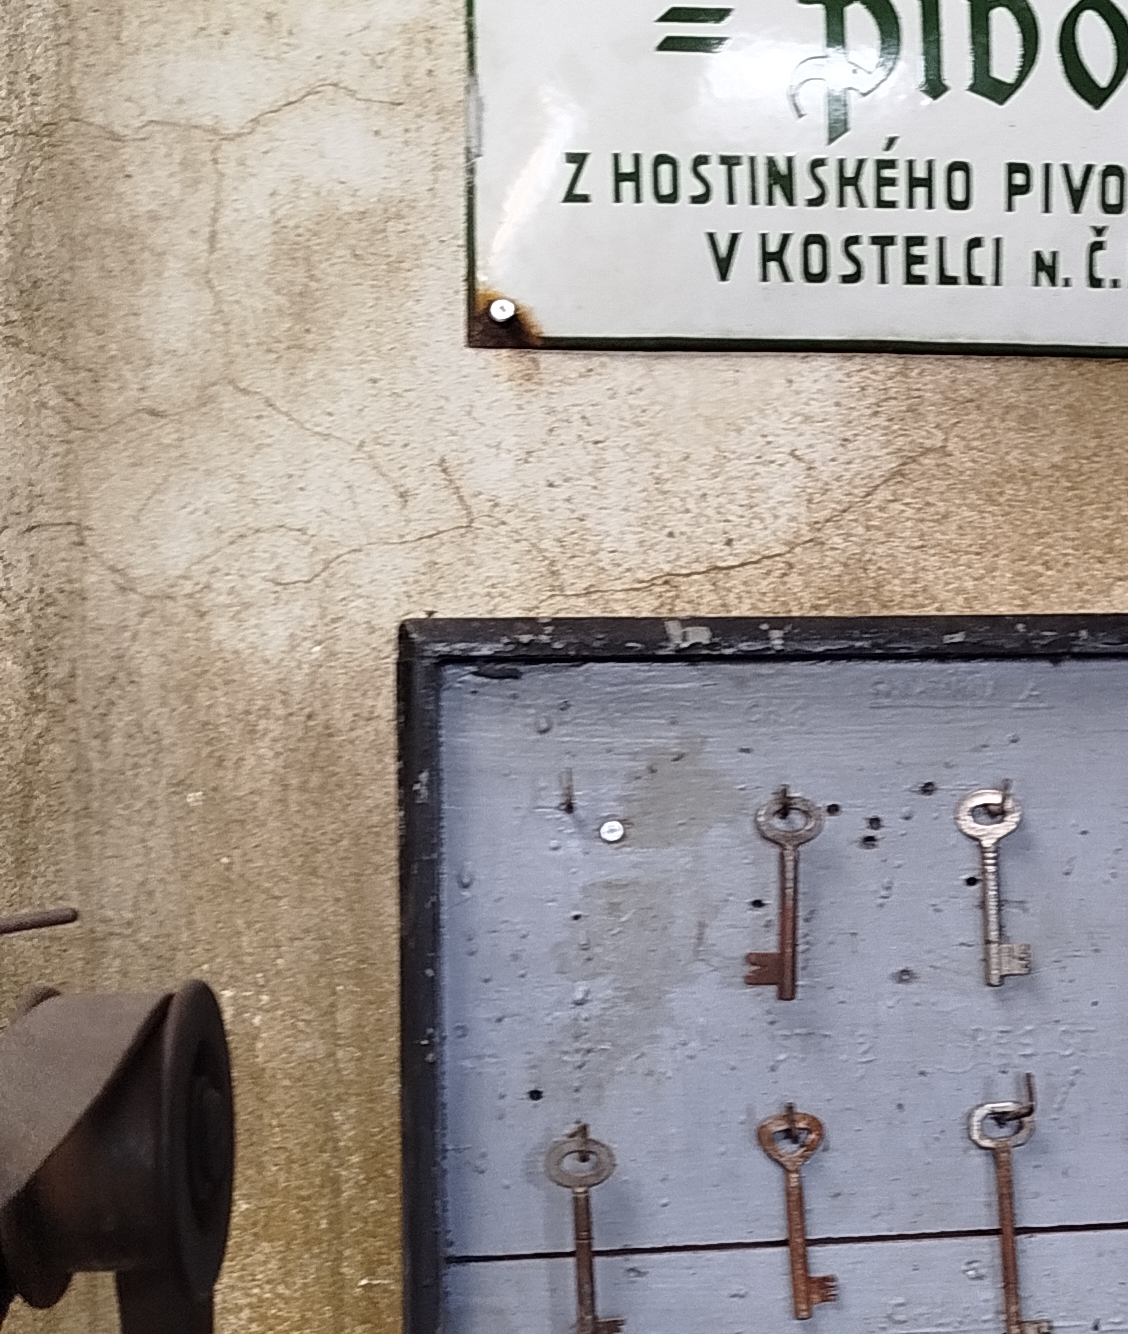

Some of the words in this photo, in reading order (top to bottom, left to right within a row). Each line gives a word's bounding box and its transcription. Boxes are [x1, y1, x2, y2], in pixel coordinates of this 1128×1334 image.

[562, 152, 592, 204] Z
[612, 136, 973, 211] HOSTINSKÉHO
[705, 232, 743, 283] V
[758, 232, 1003, 287] KOSTELCI
